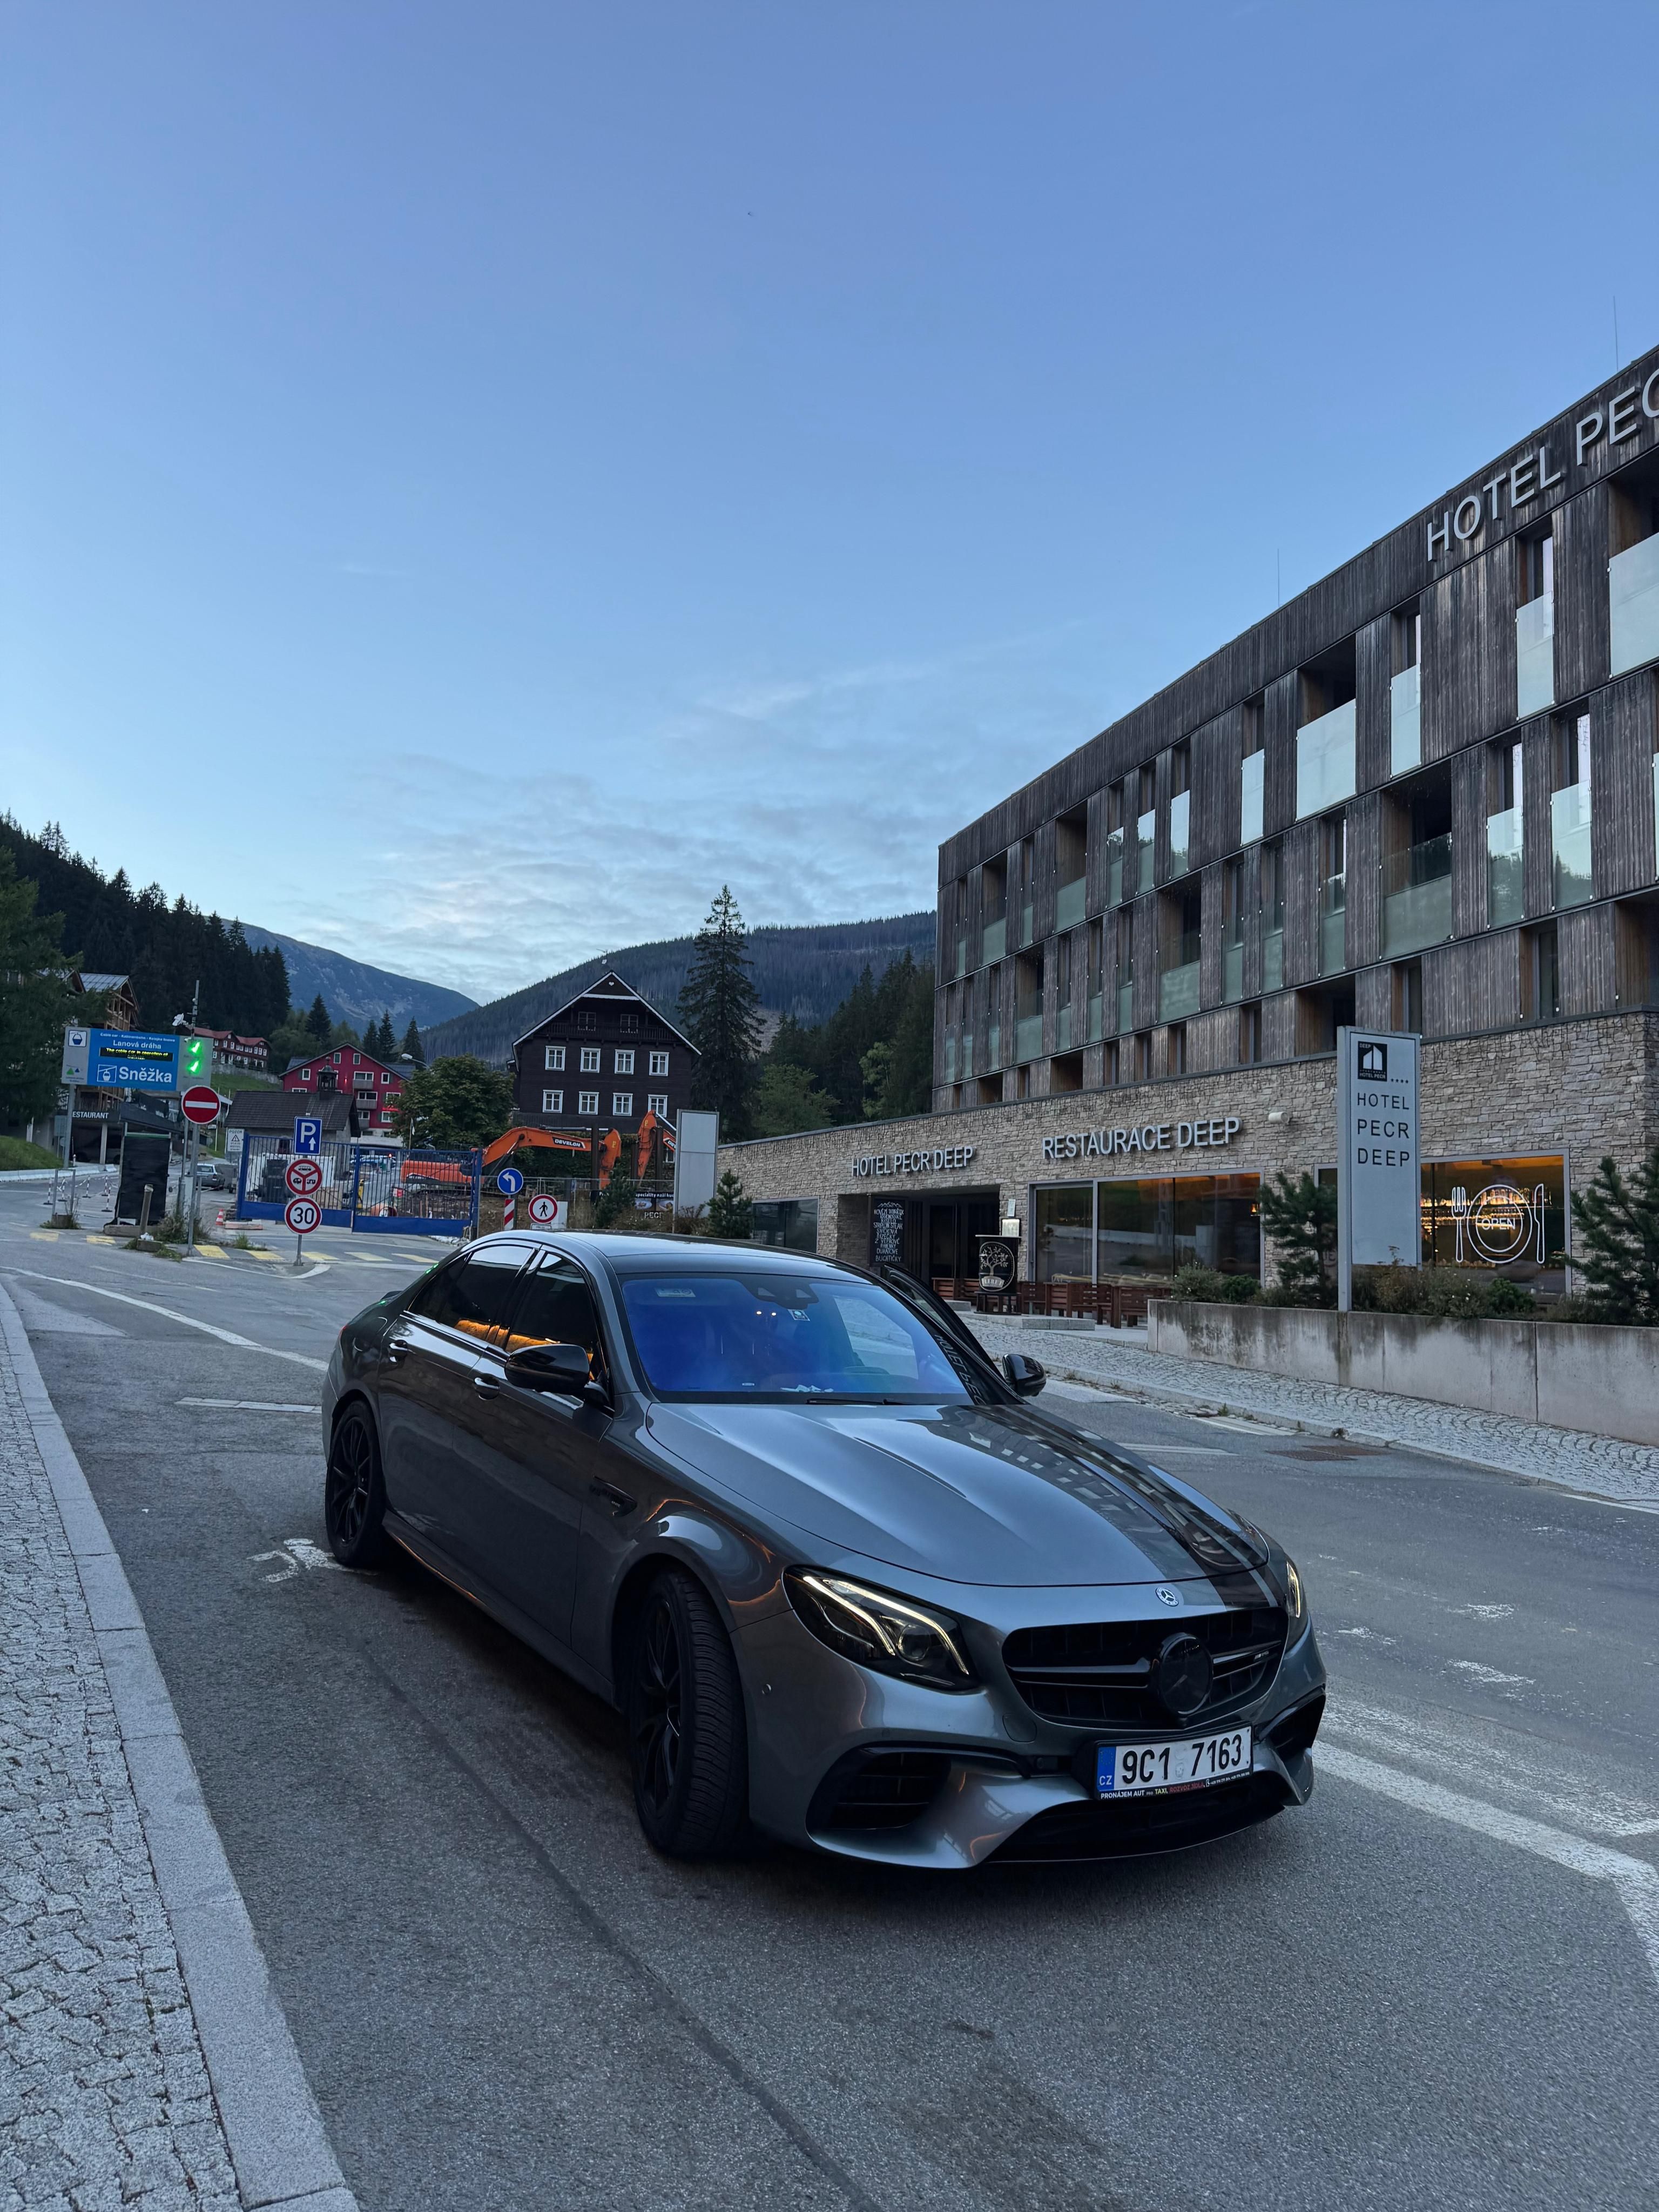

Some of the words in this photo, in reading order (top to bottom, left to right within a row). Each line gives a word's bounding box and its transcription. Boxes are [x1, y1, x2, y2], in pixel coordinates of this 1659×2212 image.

[1427, 447, 1562, 562] HOTEL
[113, 1040, 139, 1048] Lanová
[141, 1040, 161, 1049] dráha
[119, 1065, 172, 1083] Sněžka
[1357, 1092, 1410, 1110] HOTEL
[72, 1111, 109, 1119] ESTAURANT
[300, 1122, 316, 1143] P
[1042, 1123, 1171, 1159] RESTAURACE
[1177, 1116, 1240, 1148] DEEP
[1357, 1118, 1410, 1139] PECR
[555, 1139, 581, 1147] DEVELON
[852, 1155, 891, 1177] HOTEL
[894, 1151, 930, 1173] PECR
[934, 1145, 974, 1170] DEEP
[1357, 1148, 1410, 1167] DEEP
[293, 1206, 314, 1225] 30
[1481, 1217, 1516, 1230] OPEN
[1122, 1747, 1170, 1784] 9C1
[1191, 1734, 1242, 1777] 7163
[1099, 1775, 1112, 1786] CZ
[1101, 1790, 1132, 1799] PRONÁJEM
[1169, 1784, 1190, 1793] ROZVOZ
